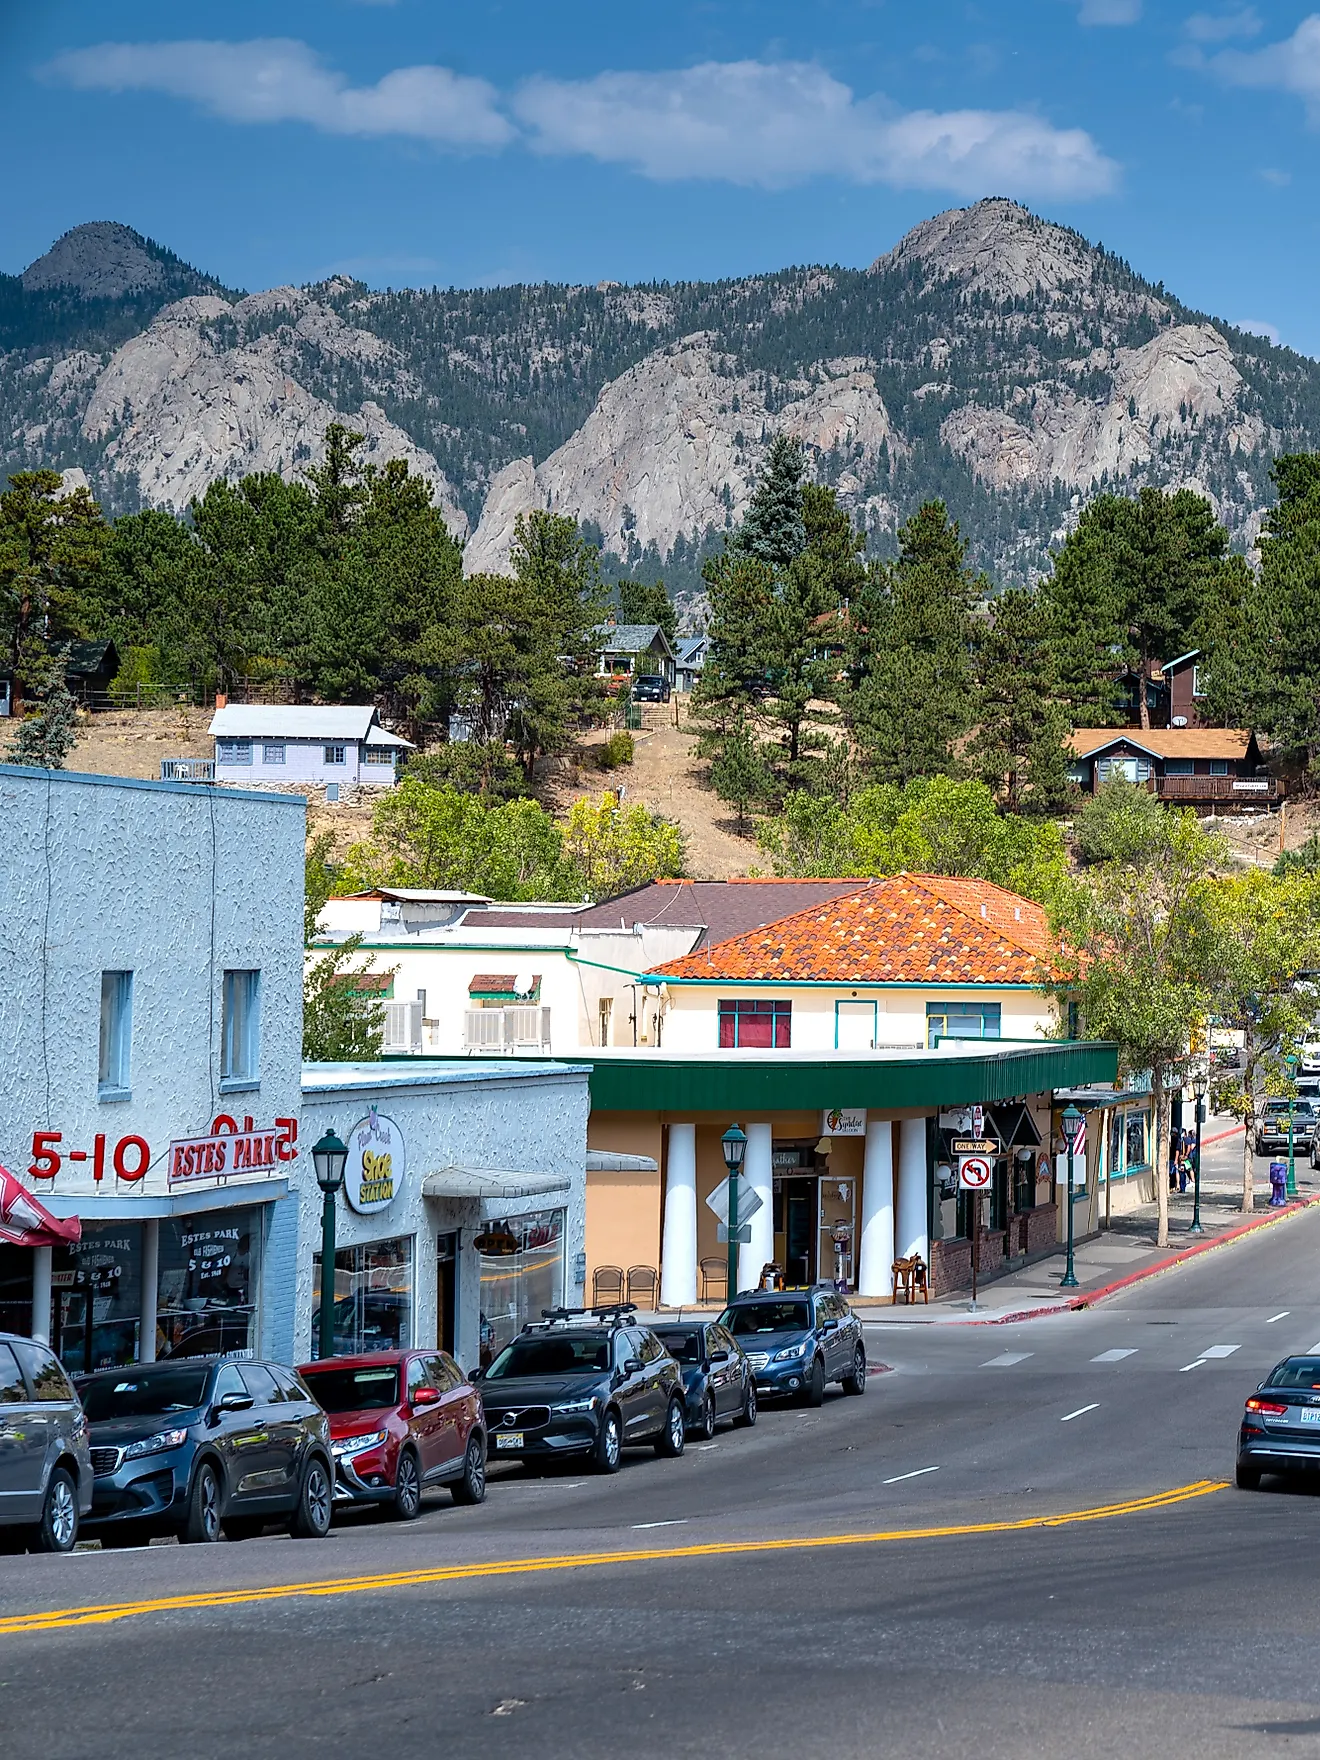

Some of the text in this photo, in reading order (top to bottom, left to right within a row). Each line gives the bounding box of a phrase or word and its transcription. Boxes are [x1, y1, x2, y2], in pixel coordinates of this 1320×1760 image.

[27, 1131, 151, 1182] 5-10
[171, 1141, 227, 1178] ESTES
[233, 1135, 275, 1169] PARK
[956, 1142, 985, 1150] ONE WAY
[362, 1149, 393, 1182] Shoe
[360, 1181, 394, 1203] STATION
[68, 1239, 131, 1256] ESTES PARK
[181, 1227, 239, 1248] ESTES PARK
[188, 1255, 231, 1272] 5 & 10
[77, 1271, 85, 1283] 5
[90, 1272, 102, 1281] &
[107, 1266, 122, 1279] 10
